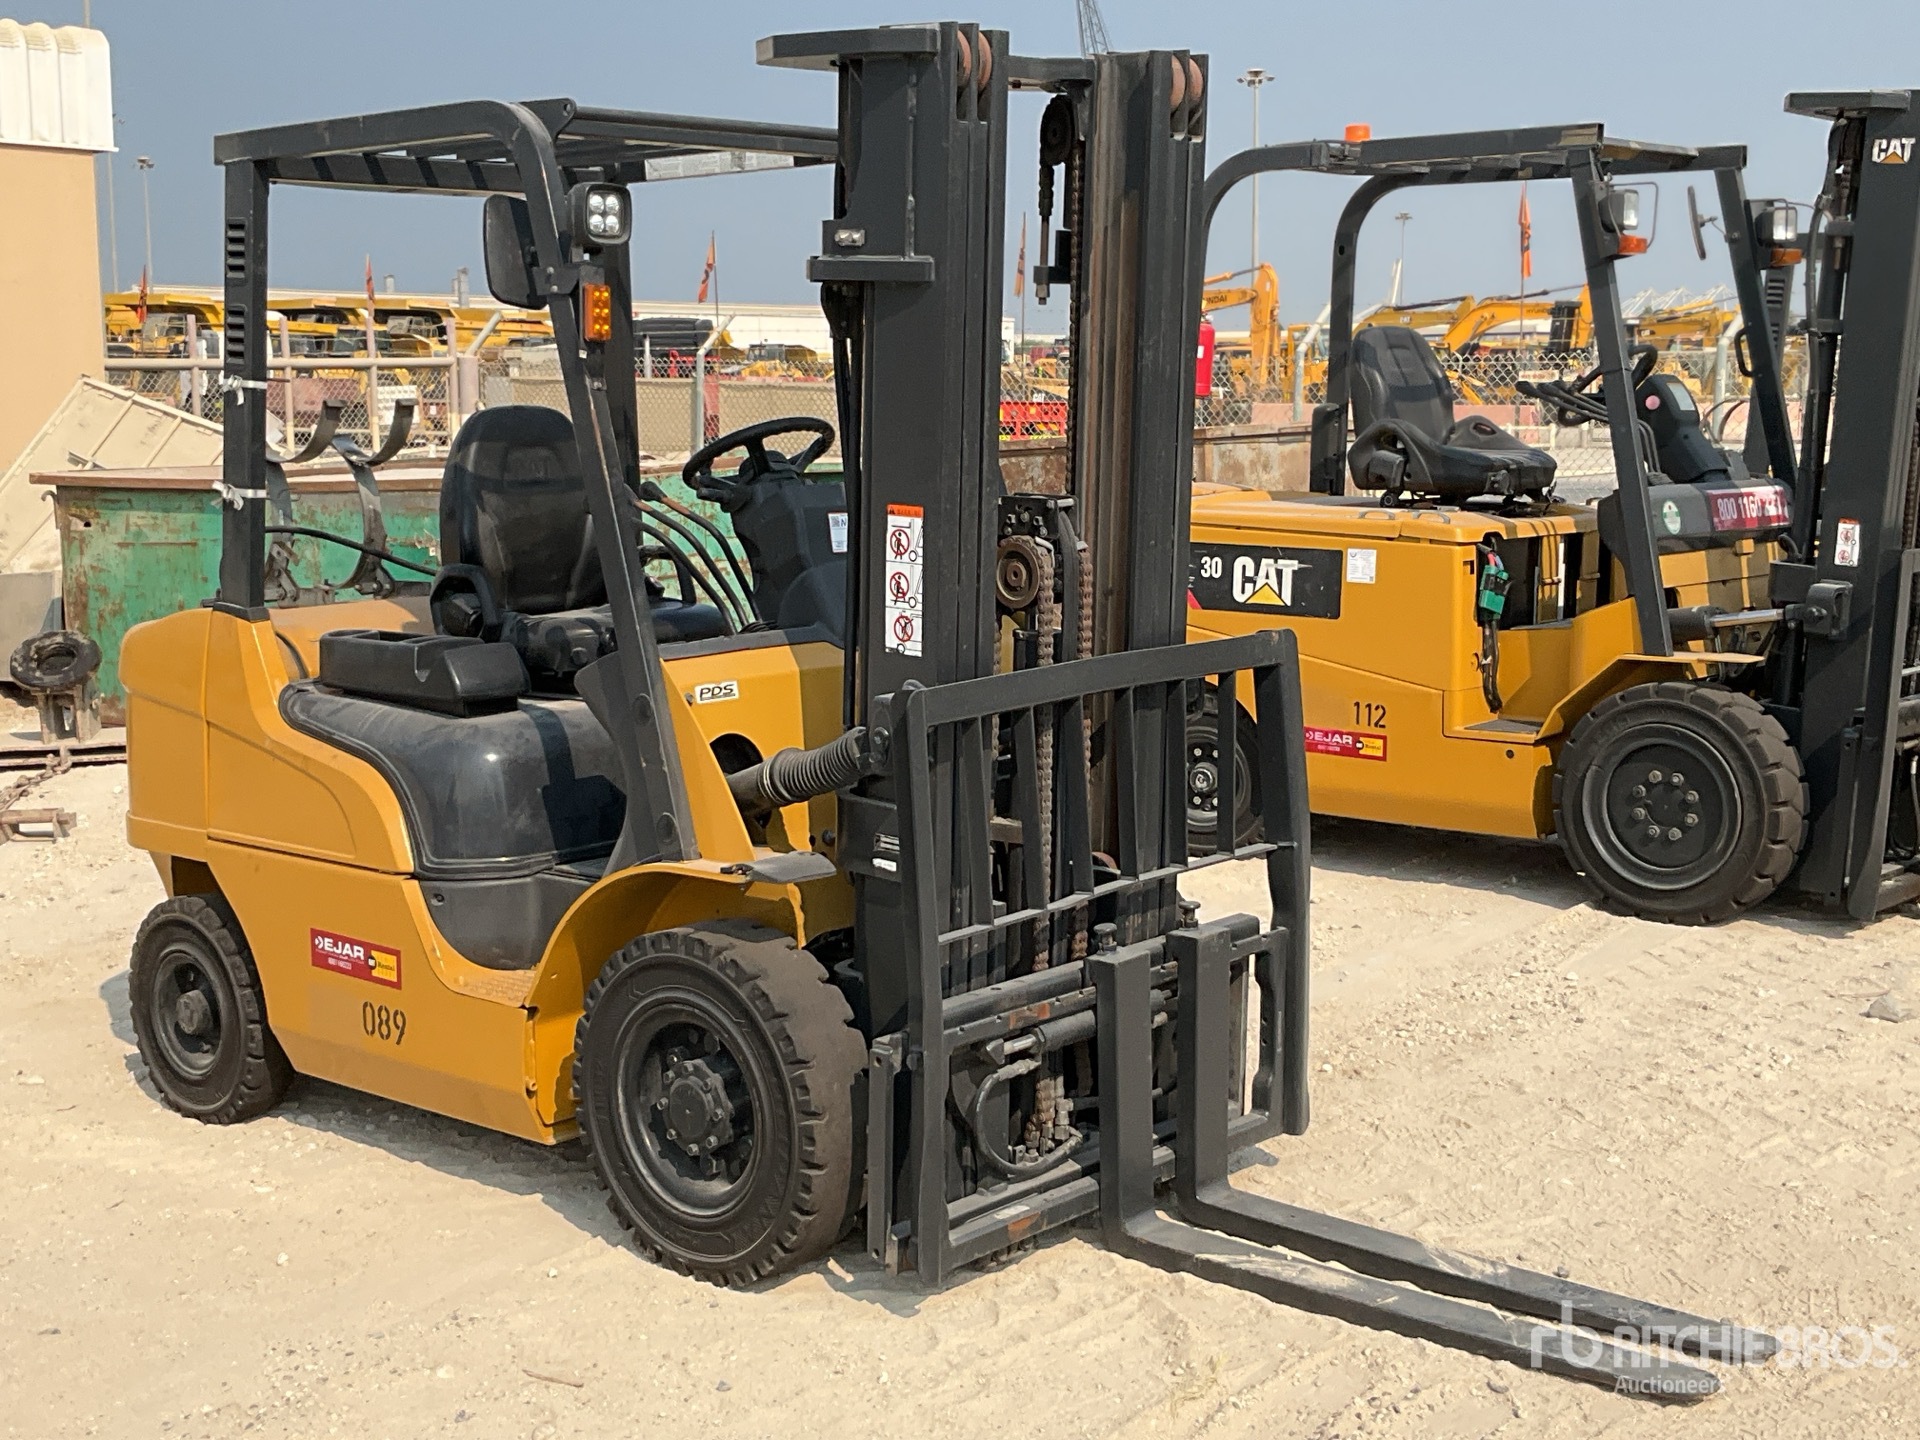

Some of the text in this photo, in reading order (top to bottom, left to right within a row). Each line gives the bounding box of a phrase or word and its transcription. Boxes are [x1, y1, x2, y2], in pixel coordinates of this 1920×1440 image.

[1872, 137, 1916, 164] CAT
[1032, 392, 1046, 402] CAT
[1717, 497, 1737, 520] 800
[1738, 495, 1762, 518] 1160
[1201, 556, 1223, 578] 30
[1232, 555, 1299, 606] CAT
[700, 684, 735, 698] PDS
[1353, 701, 1387, 729] 112
[1314, 731, 1353, 745] EJAR
[323, 937, 365, 961] EJAR
[362, 1001, 407, 1046] 089
